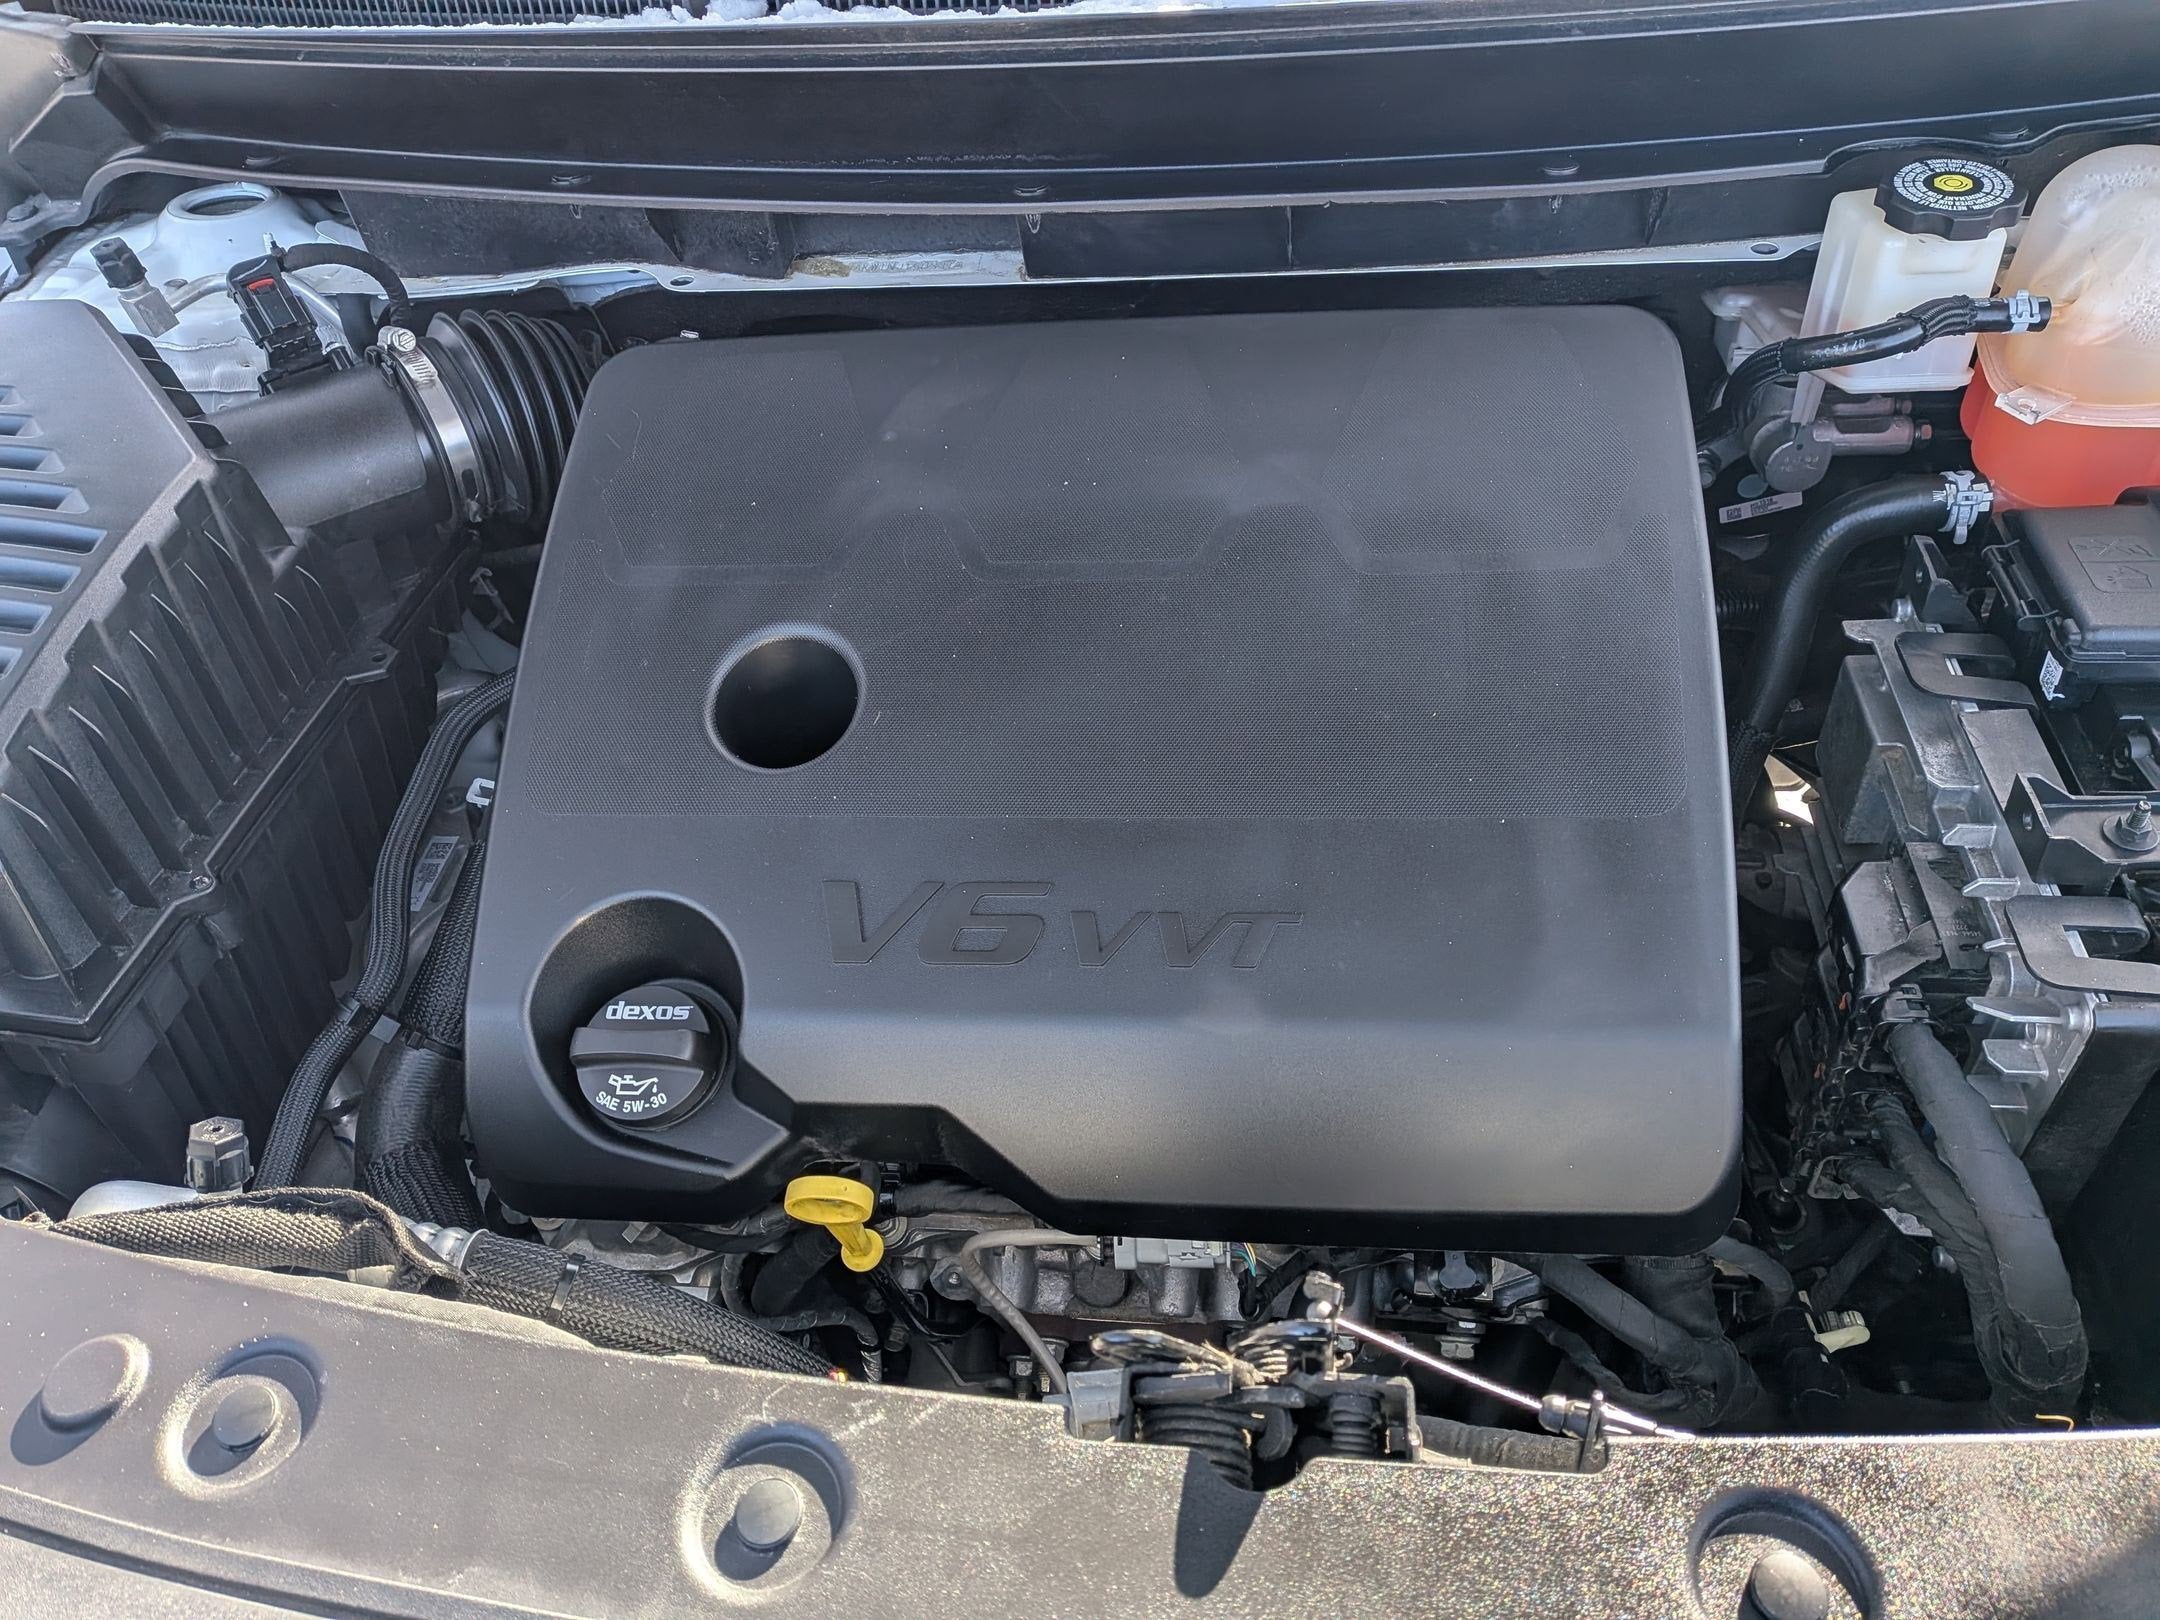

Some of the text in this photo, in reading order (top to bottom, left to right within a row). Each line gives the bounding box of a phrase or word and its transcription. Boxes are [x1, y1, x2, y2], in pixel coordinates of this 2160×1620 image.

[822, 879, 1304, 969] V6 VVT
[605, 1001, 691, 1020] dexos
[595, 1091, 668, 1113] SAE 5W-30
